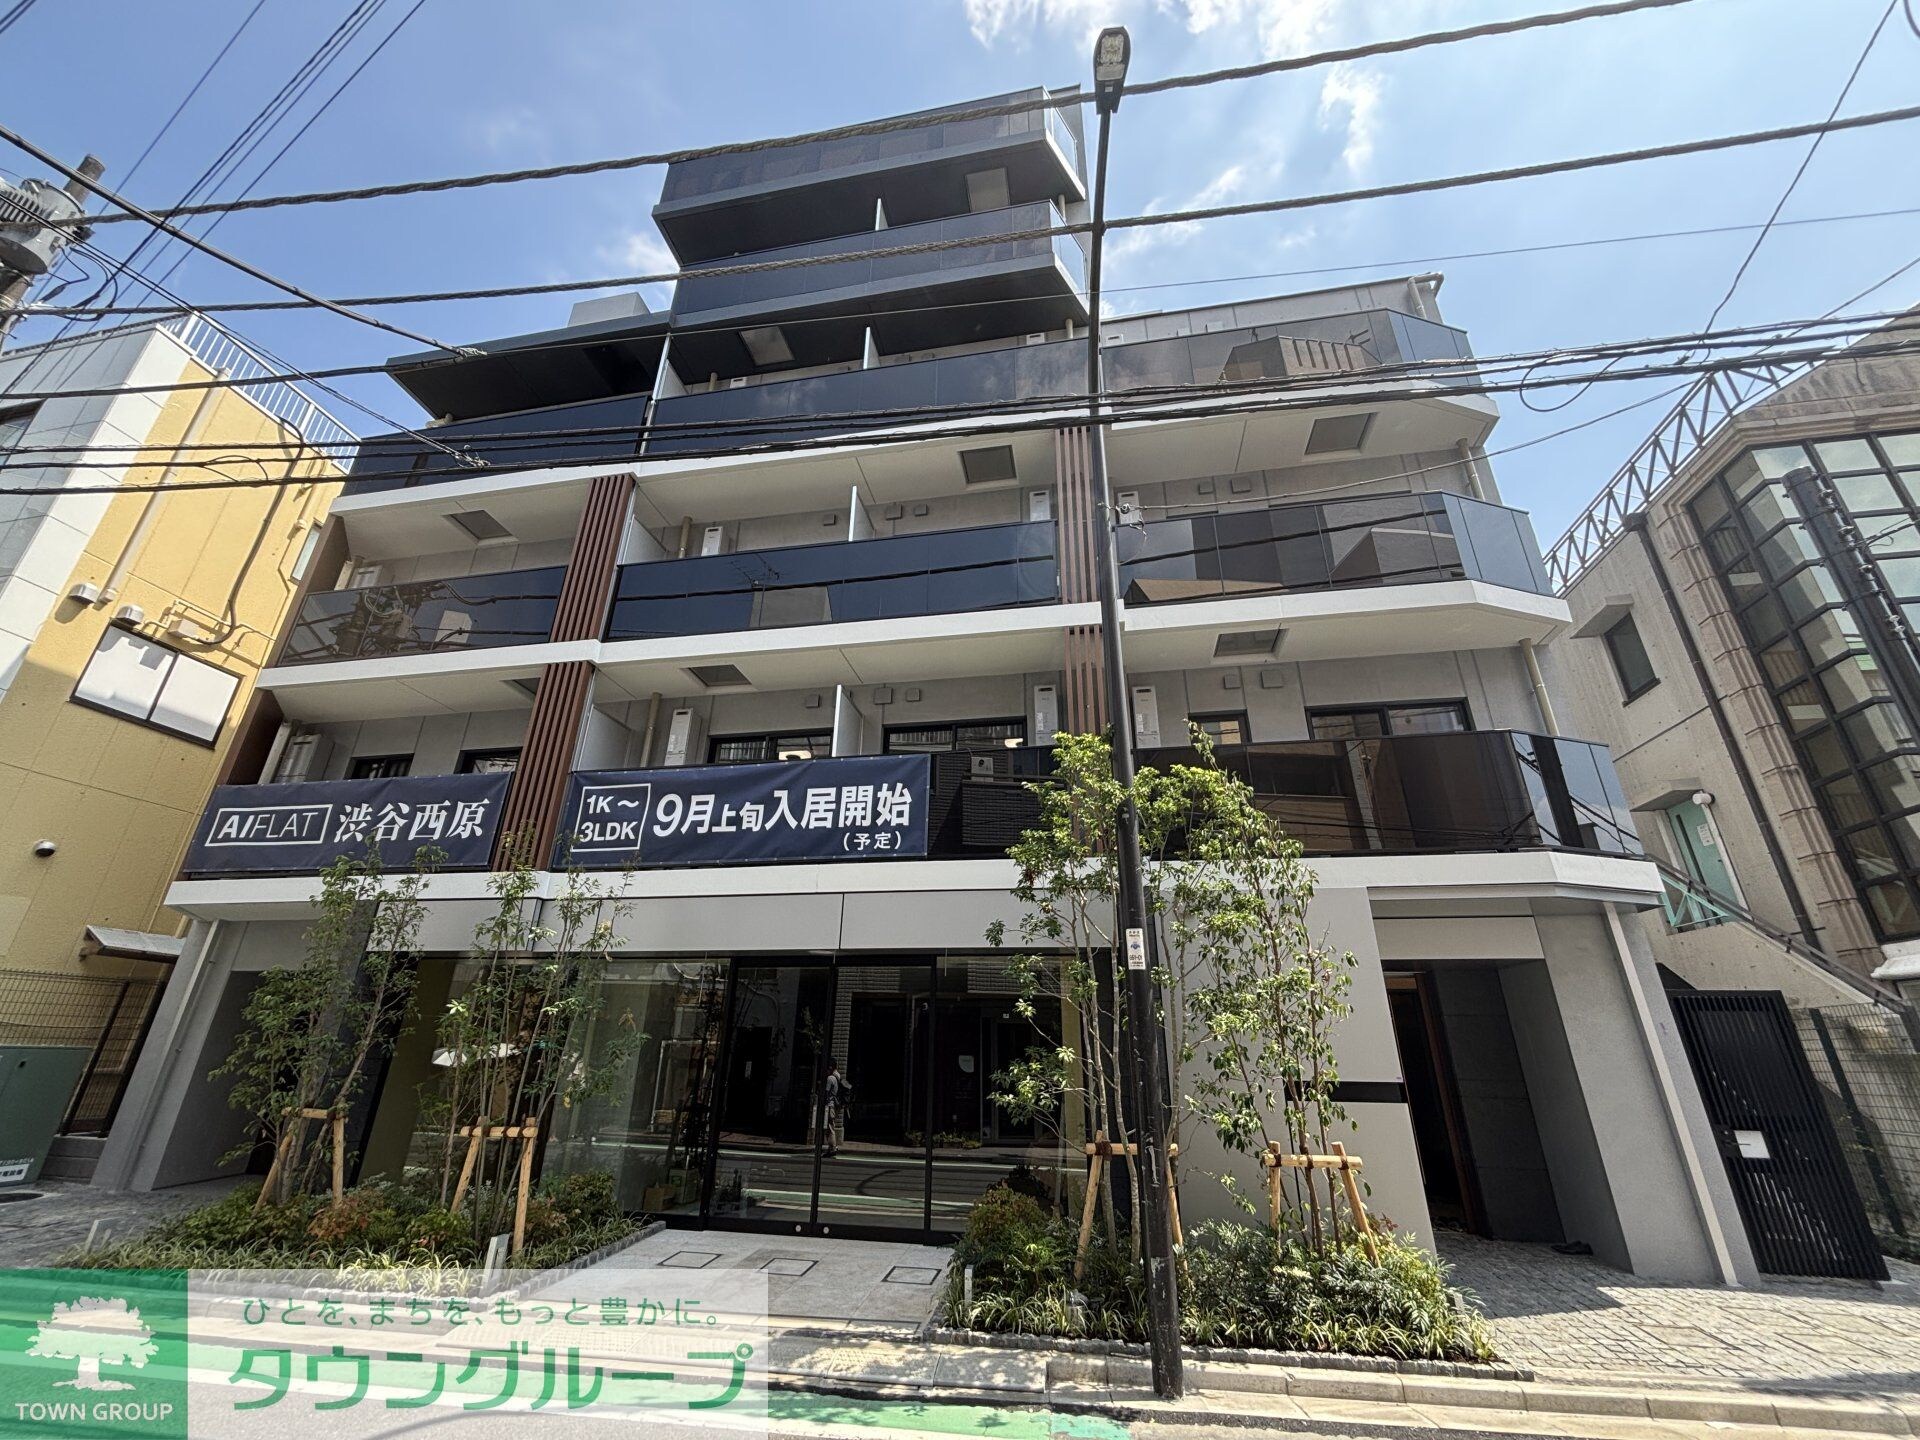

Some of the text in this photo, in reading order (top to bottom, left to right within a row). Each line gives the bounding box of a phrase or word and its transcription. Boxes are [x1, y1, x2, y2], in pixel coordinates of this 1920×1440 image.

[217, 798, 490, 843] AIFLAT 渋谷西原
[652, 782, 913, 837] 9月上旬入居開始
[579, 821, 638, 843] 3LDK
[843, 830, 902, 851] (予定)
